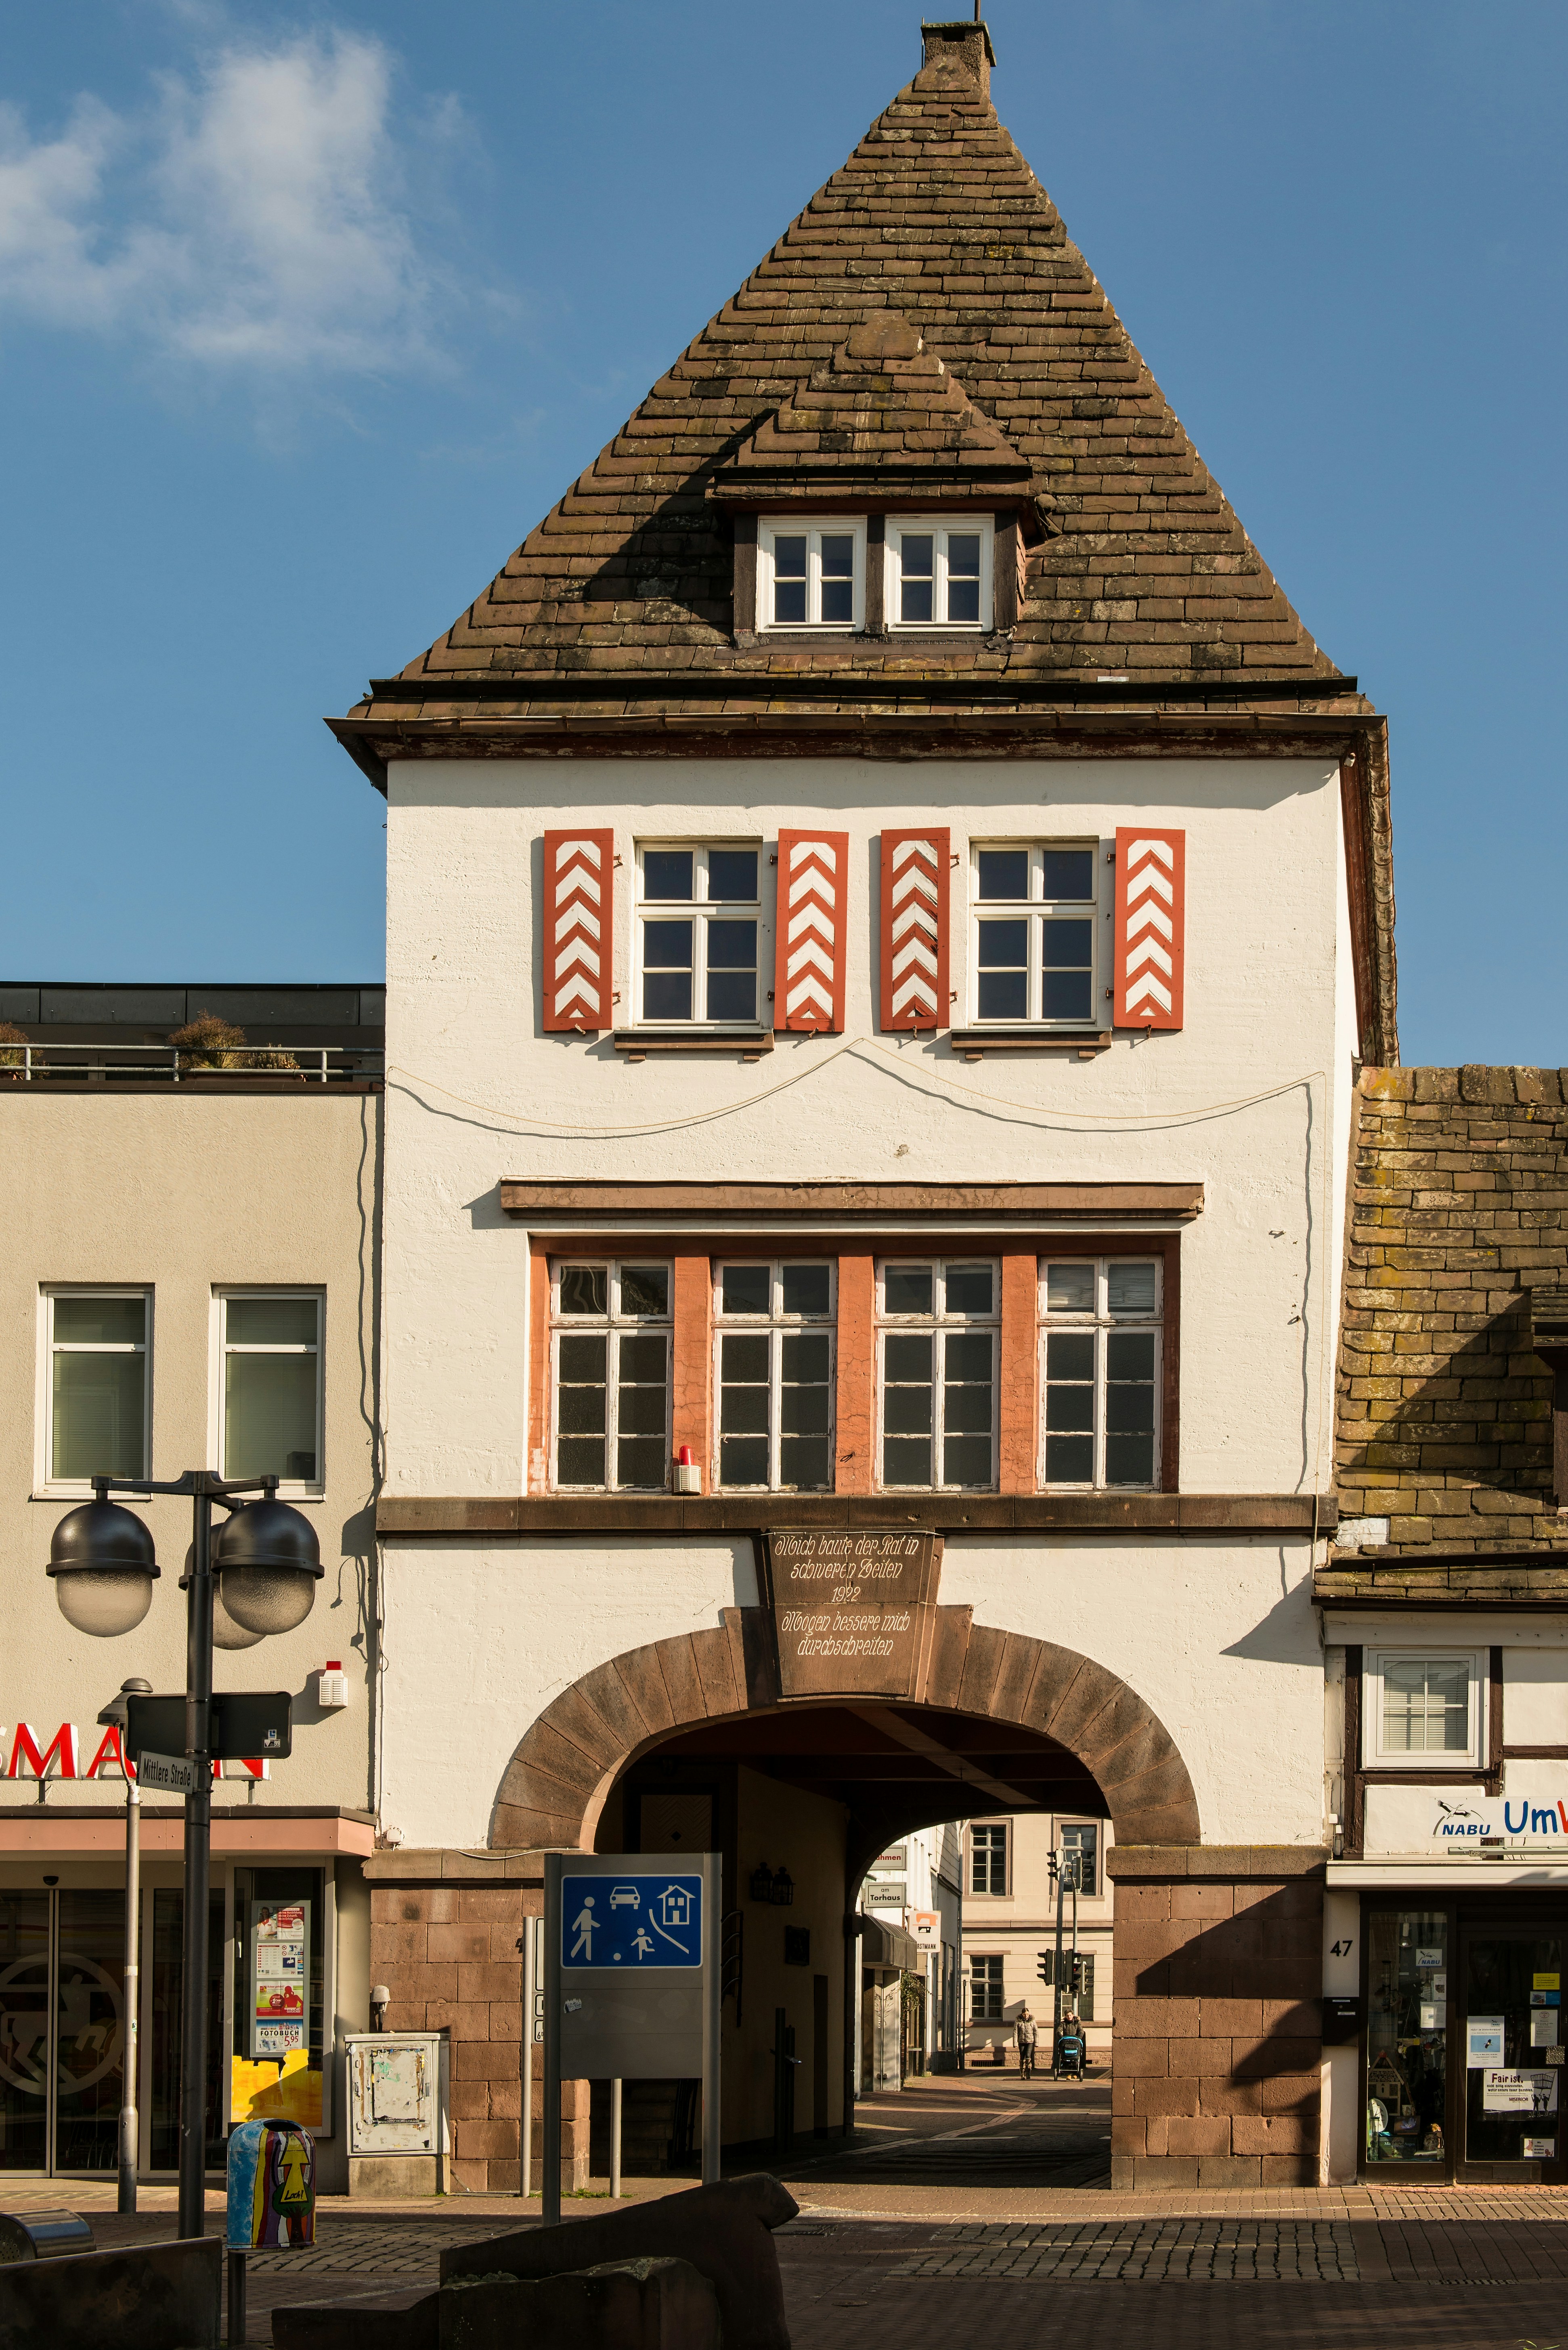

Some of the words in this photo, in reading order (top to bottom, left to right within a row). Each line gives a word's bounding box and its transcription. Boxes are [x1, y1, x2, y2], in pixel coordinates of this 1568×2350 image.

[818, 1536, 852, 1555] baute
[855, 1536, 878, 1555] der
[878, 1535, 906, 1555] Rat
[905, 1536, 919, 1555] in
[791, 1559, 856, 1579] schweren
[858, 1558, 903, 1578] Zeiten
[832, 1586, 860, 1602] 1922
[832, 1611, 880, 1631] bessere
[881, 1611, 910, 1631] mich
[797, 1636, 894, 1655] durchschreiten
[143, 1758, 168, 1782] Mittlere
[171, 1764, 191, 1787] Straße
[1442, 1825, 1490, 1835] NABU
[1330, 1940, 1353, 1957] 47
[1492, 2073, 1508, 2083] Fair
[1510, 2075, 1523, 2084] ist,
